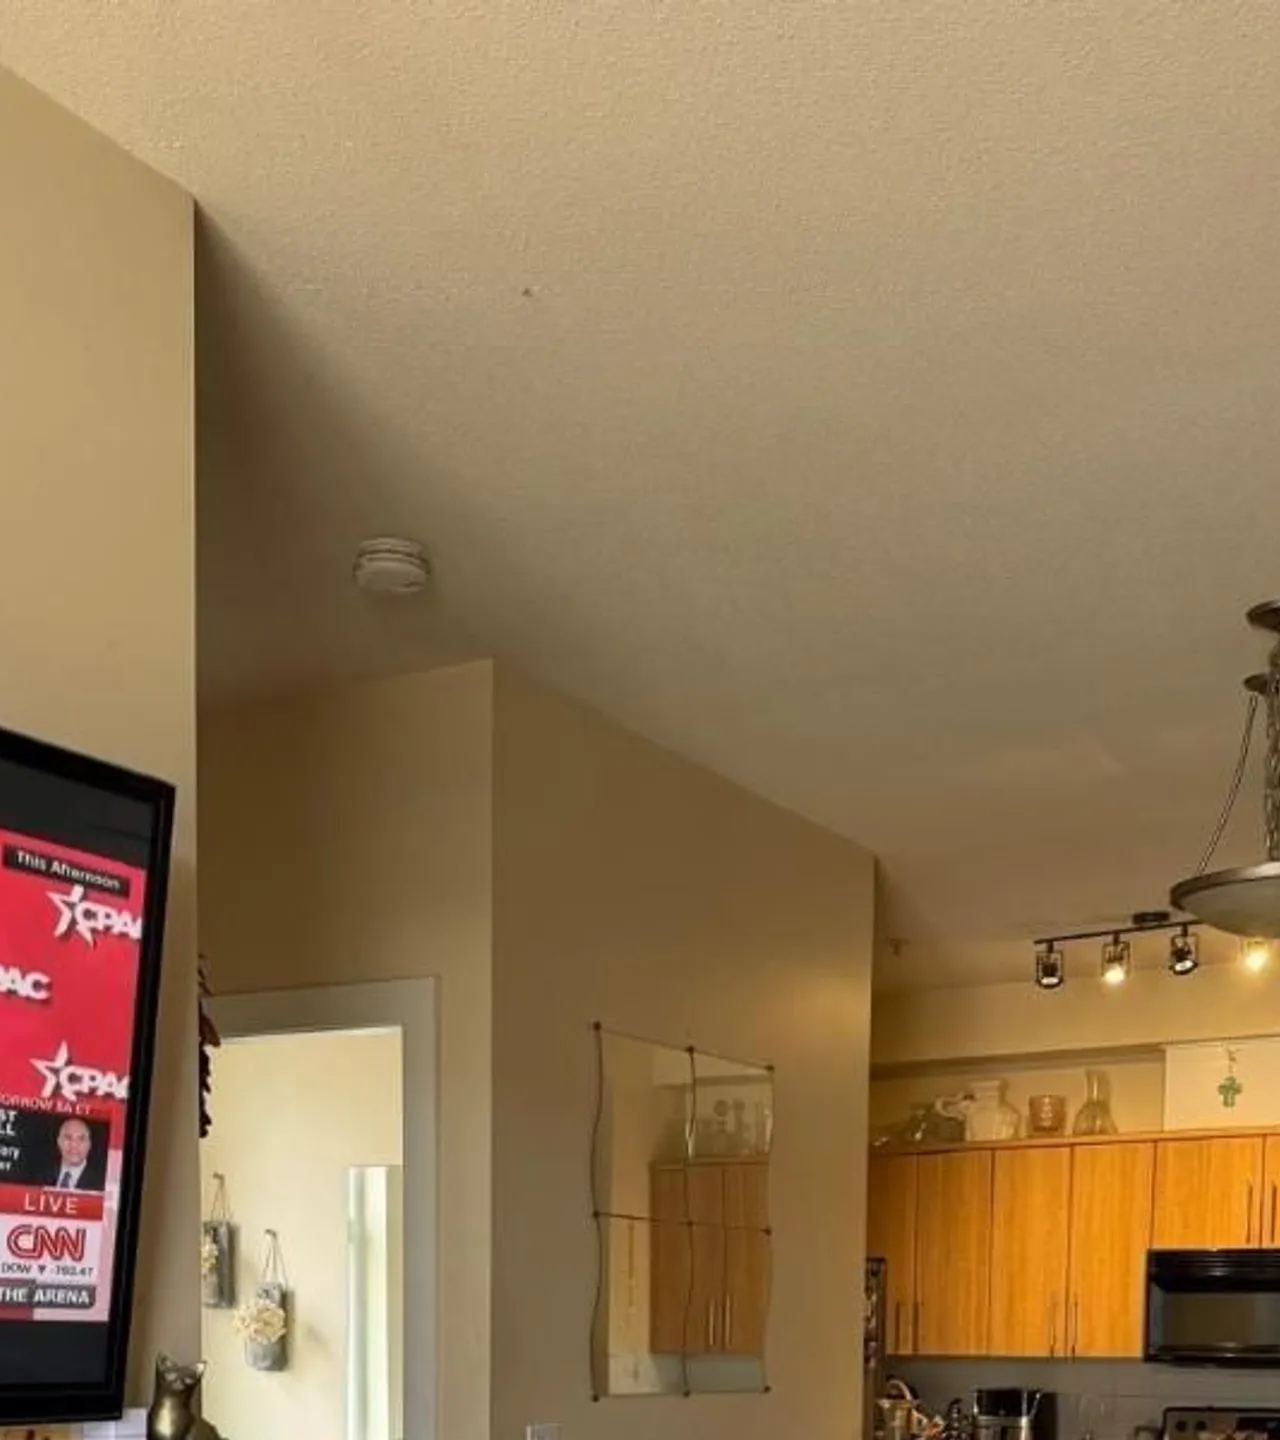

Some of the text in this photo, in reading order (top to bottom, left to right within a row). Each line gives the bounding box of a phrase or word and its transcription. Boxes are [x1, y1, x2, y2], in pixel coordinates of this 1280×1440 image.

[17, 850, 121, 889] This Afternoon
[75, 900, 142, 942] CPA
[24, 1193, 79, 1215] LIVE
[6, 1223, 87, 1263] CNN
[1, 1262, 32, 1274] DOW
[34, 1288, 90, 1306] ARENA
